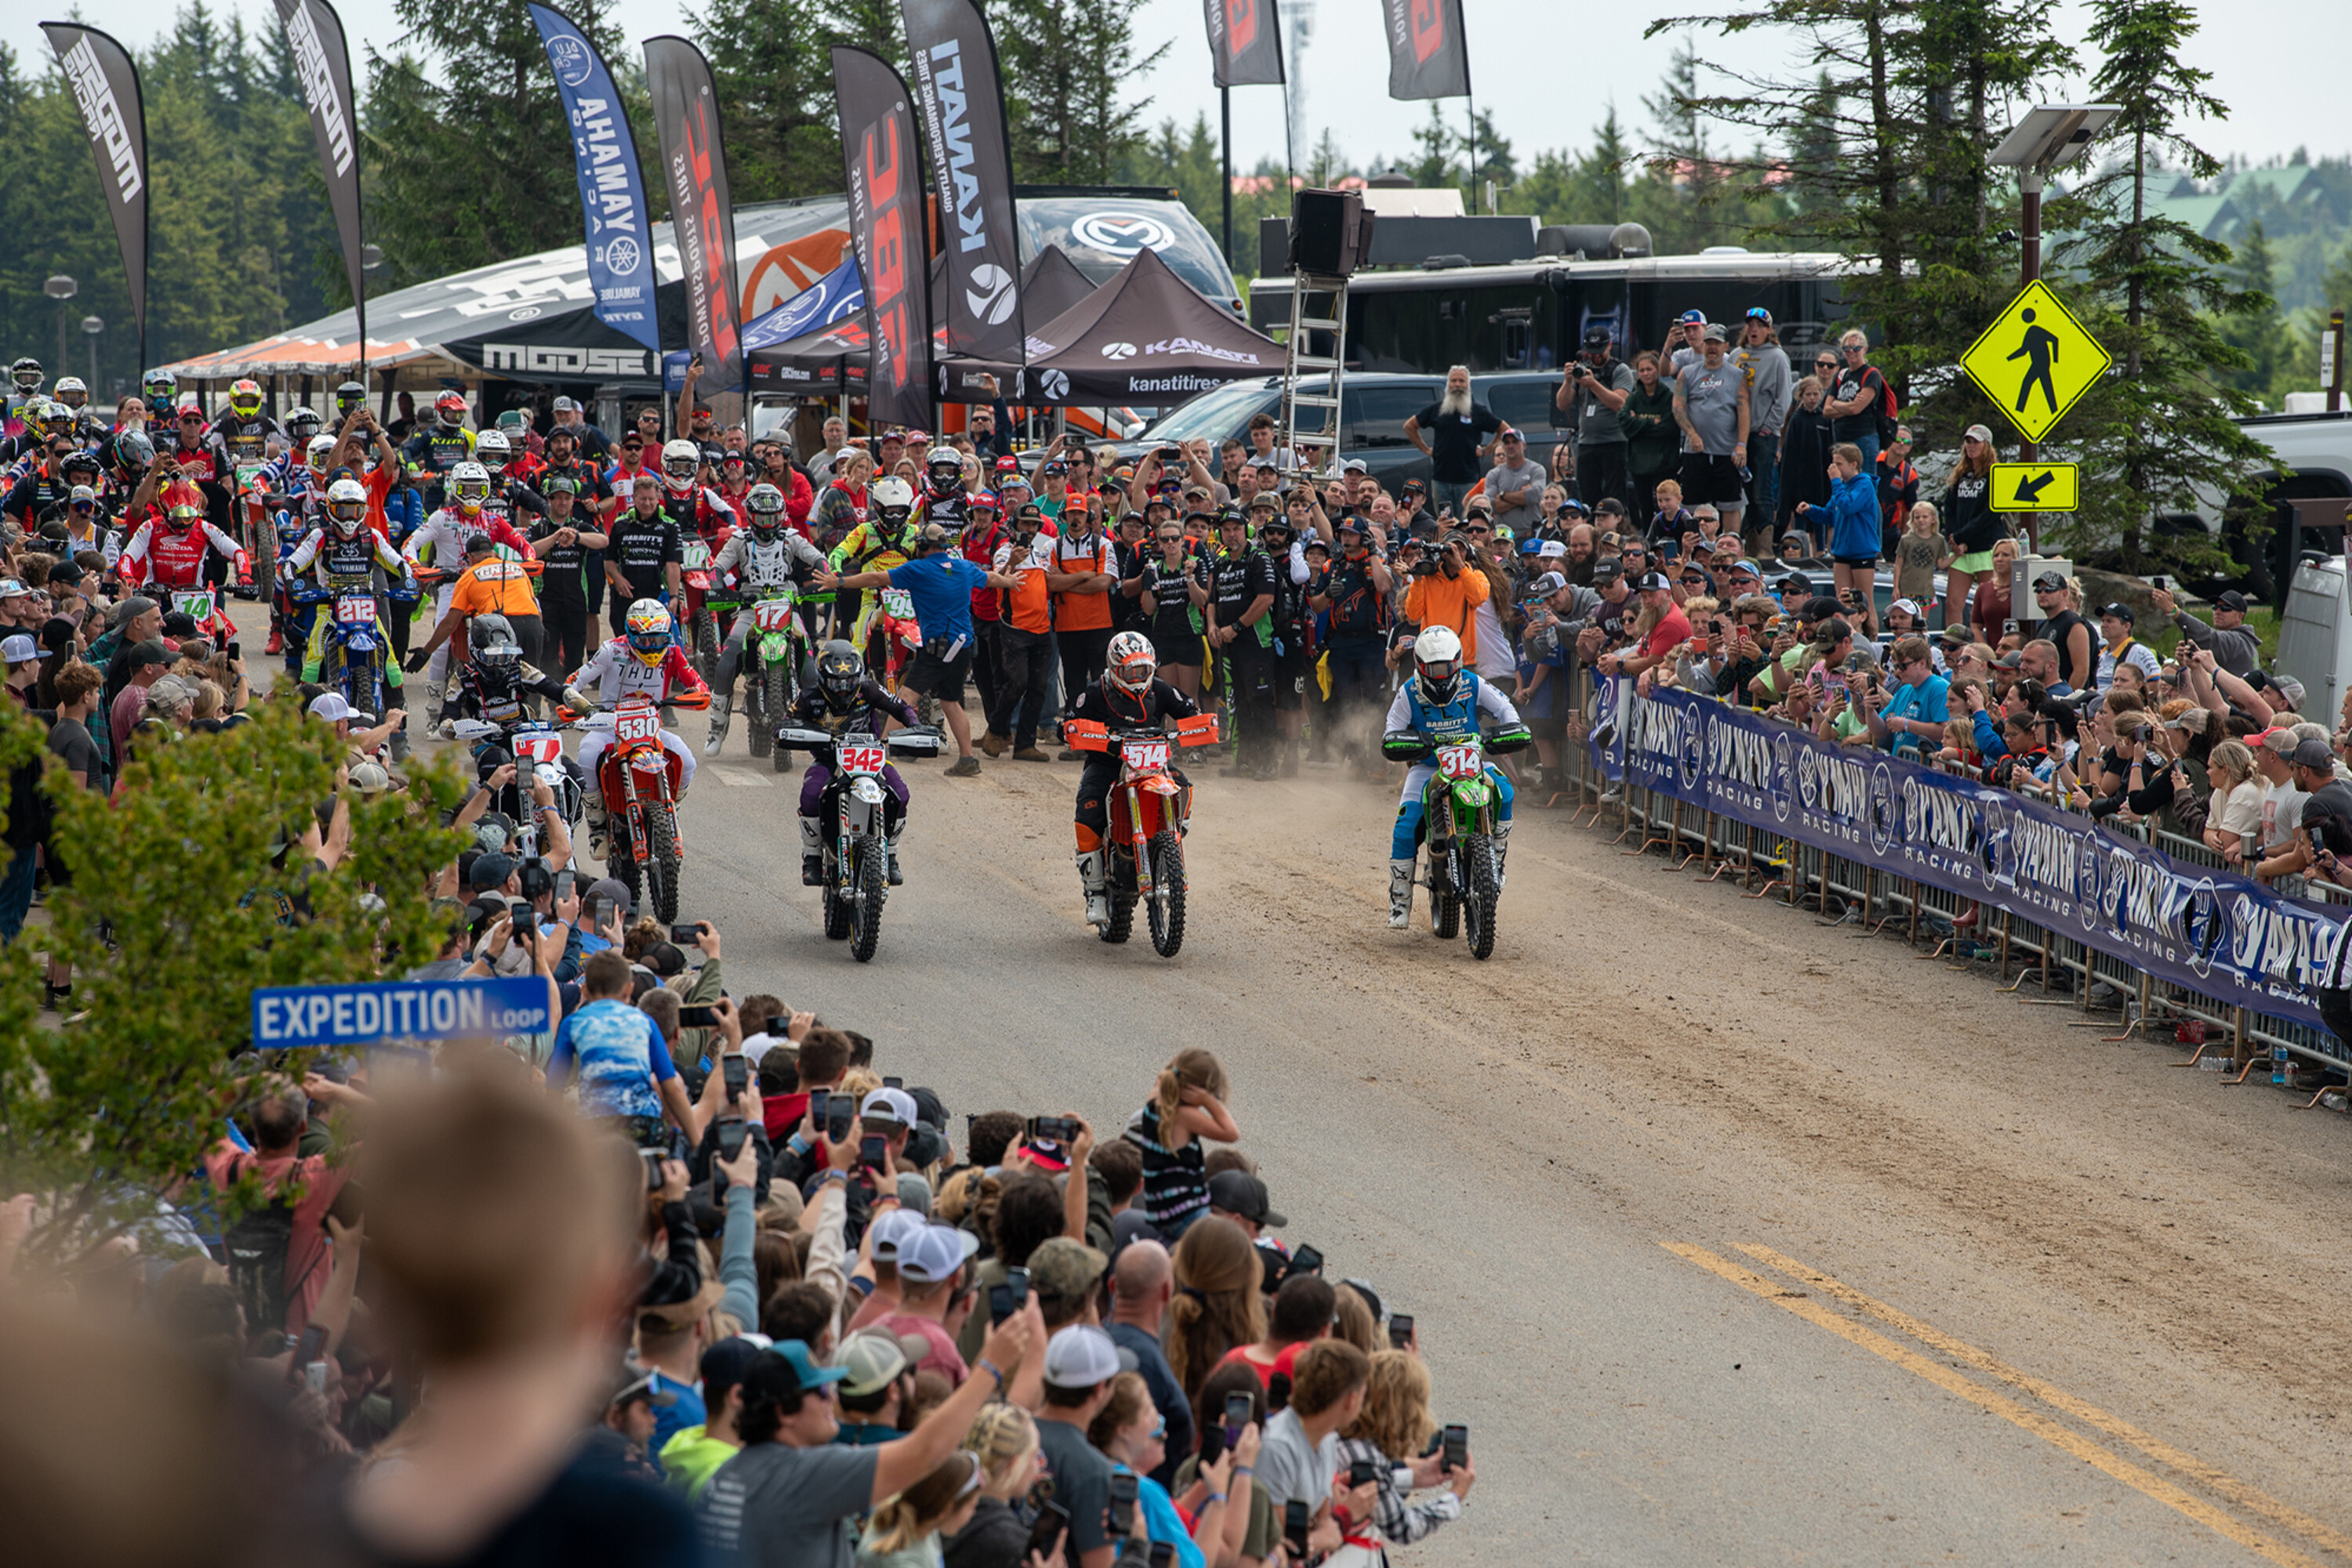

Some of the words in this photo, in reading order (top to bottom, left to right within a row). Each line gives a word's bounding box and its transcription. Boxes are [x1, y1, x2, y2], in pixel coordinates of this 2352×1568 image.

[483, 343, 648, 376] MOOSE
[1145, 337, 1260, 364] KANATI
[752, 364, 772, 374] GBC
[819, 367, 837, 377] GBC
[847, 367, 867, 378] GBC
[341, 564, 367, 572] YAMAHA
[182, 598, 209, 618] 14
[338, 600, 376, 622] 212
[757, 604, 790, 627] 17
[1421, 699, 1468, 720] FLY
[619, 717, 659, 741] 530
[1426, 717, 1468, 728] BABBITT'S
[529, 739, 547, 761] 1
[842, 748, 883, 772] 342
[1127, 745, 1167, 768] 514
[1442, 749, 1480, 775] 314
[1630, 754, 1673, 778] RACING
[1707, 780, 1762, 811] RACING
[1803, 811, 1860, 844] RACING
[1905, 846, 1973, 880] RACING
[2012, 884, 2071, 917] RACING
[2111, 925, 2176, 963] RACING
[260, 988, 484, 1040] EXPEDITION
[492, 1008, 545, 1029] LOOP
